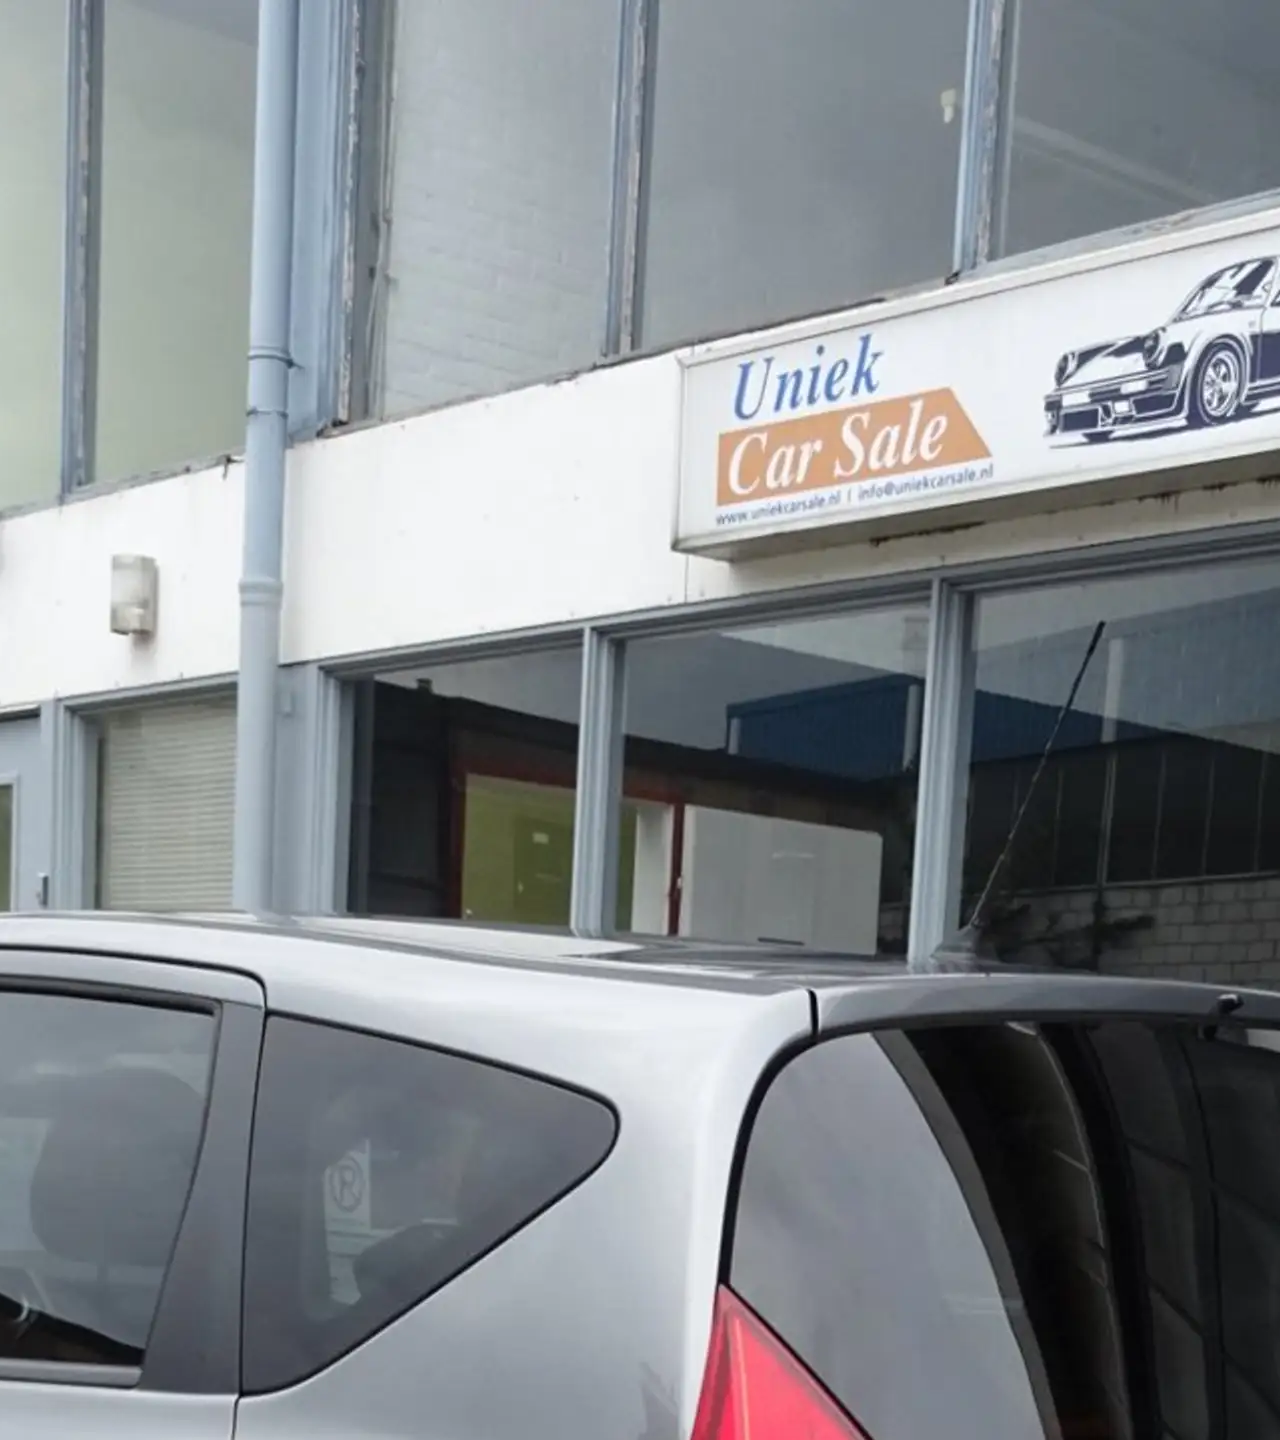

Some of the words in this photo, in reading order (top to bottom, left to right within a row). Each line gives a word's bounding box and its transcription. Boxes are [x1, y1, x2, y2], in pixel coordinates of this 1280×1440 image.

[733, 333, 884, 420] Uniek
[728, 431, 823, 495] Car
[832, 399, 948, 479] Sale
[716, 490, 842, 526] www.uniekcarsale.nl
[857, 463, 994, 503] info@uniekcarsale.nl
